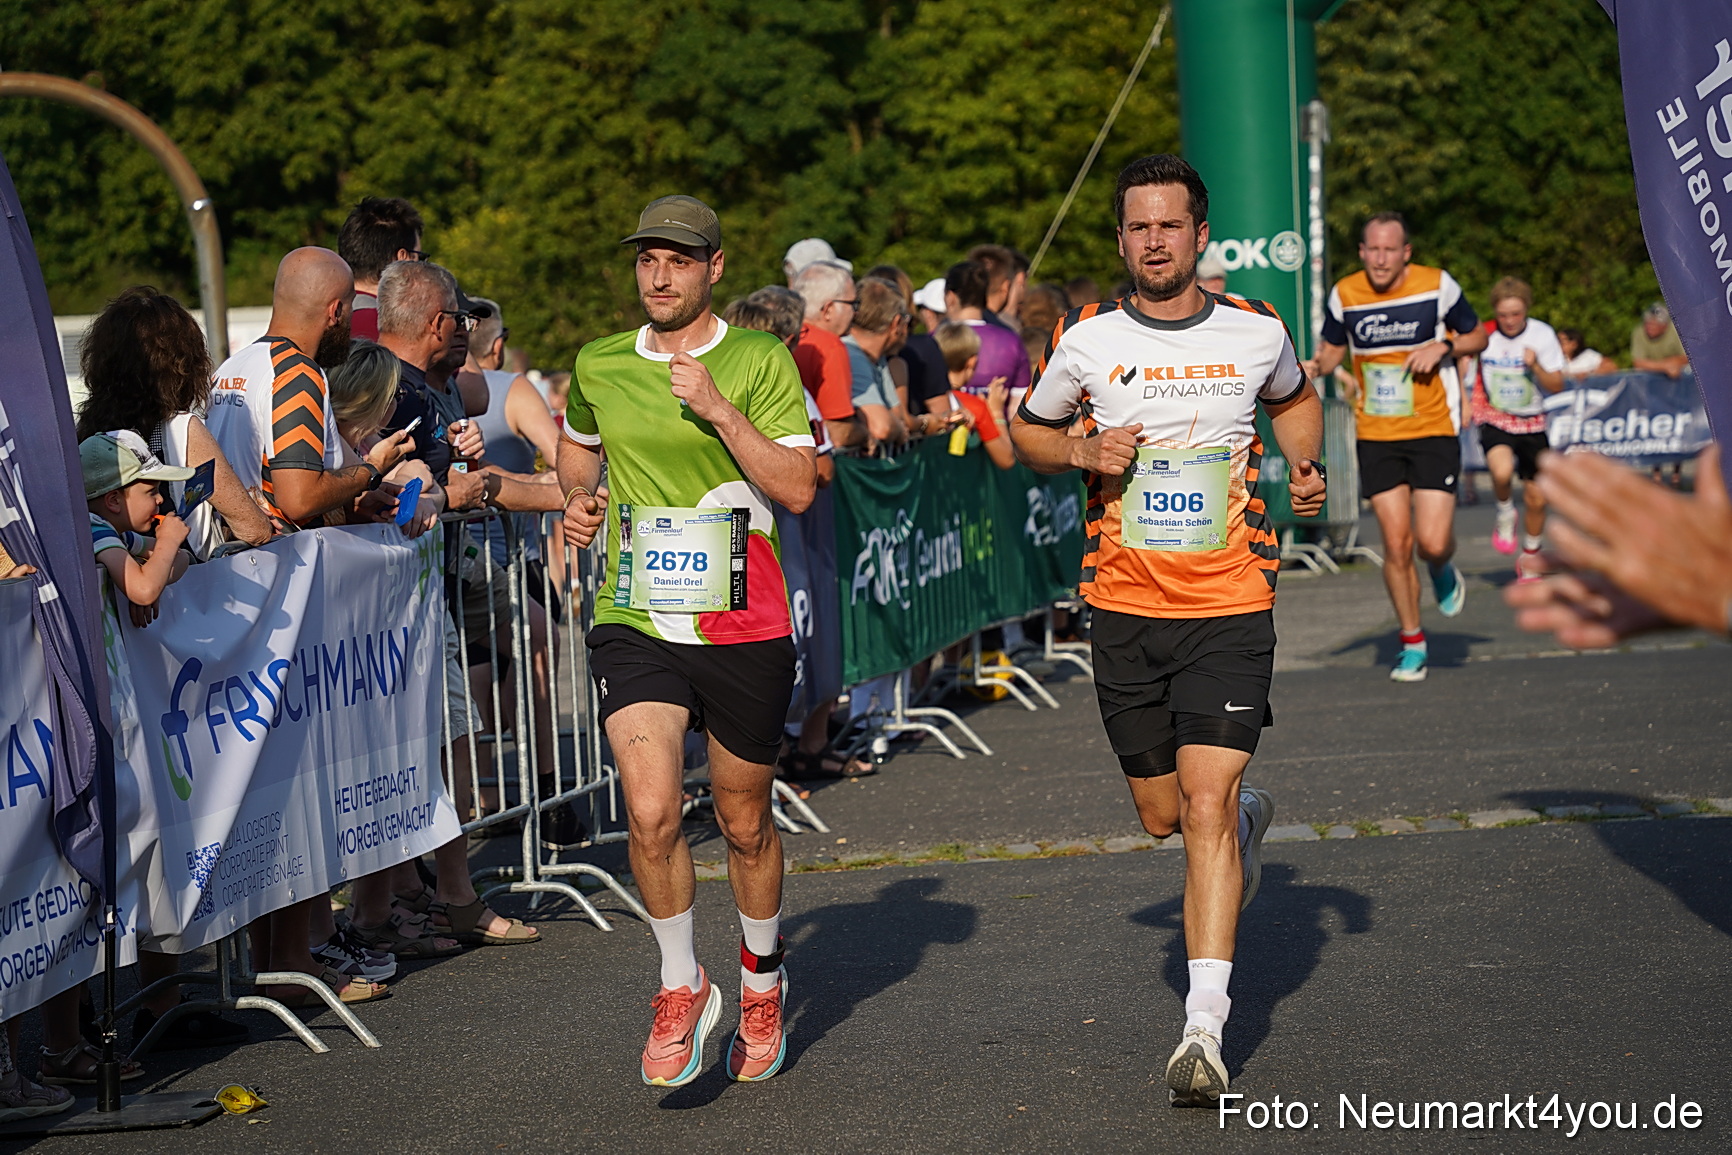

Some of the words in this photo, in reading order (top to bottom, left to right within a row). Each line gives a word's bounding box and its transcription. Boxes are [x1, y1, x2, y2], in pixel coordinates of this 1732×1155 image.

[1144, 363, 1245, 381] KLEBL
[1143, 382, 1245, 400] DYNAMICS
[1549, 408, 1692, 448] Fischer
[1143, 491, 1204, 513] 1306
[1137, 516, 1183, 527] Sebastian
[1185, 517, 1212, 527] Schön
[645, 550, 708, 572] 2678
[653, 576, 682, 586] Daniel
[684, 577, 703, 587] Orel
[205, 626, 409, 755] FRISCHMANN
[334, 781, 373, 816] HEUTE
[372, 766, 420, 804] GEDACHT,
[243, 811, 281, 844] LOGISTICS
[336, 820, 386, 858] MORGEN
[385, 802, 435, 841] GEMACHT.
[219, 843, 265, 880] CORPORATE
[265, 834, 289, 860] PRINT
[222, 869, 266, 907] CORPORATE
[266, 855, 304, 887] SIGNAGE
[0, 939, 55, 991] ORGEN
